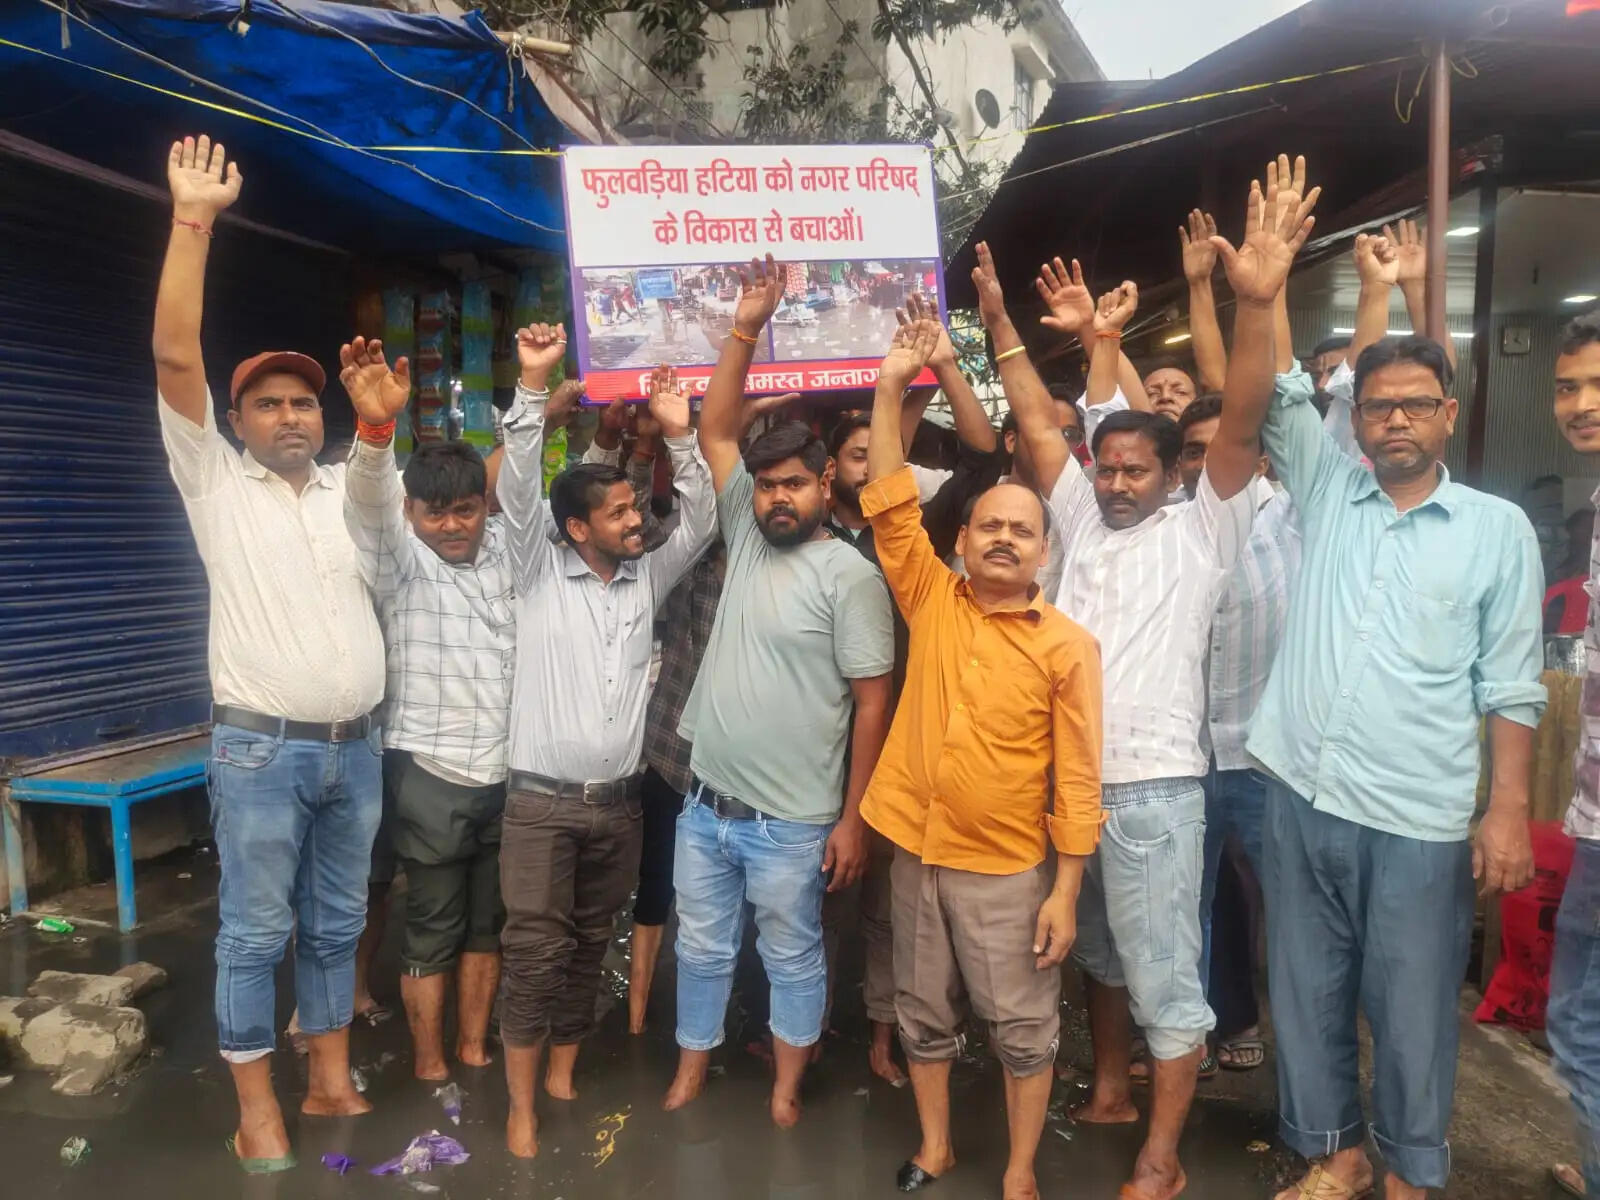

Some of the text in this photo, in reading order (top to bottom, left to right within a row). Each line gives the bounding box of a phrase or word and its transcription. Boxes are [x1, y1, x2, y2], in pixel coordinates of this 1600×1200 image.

[581, 156, 920, 209] फुलवड़िया हटिया को नगर परिषद्
[653, 211, 678, 245] के
[683, 209, 757, 245] विकास
[763, 208, 782, 243] से
[807, 367, 881, 387] जन्ताग
